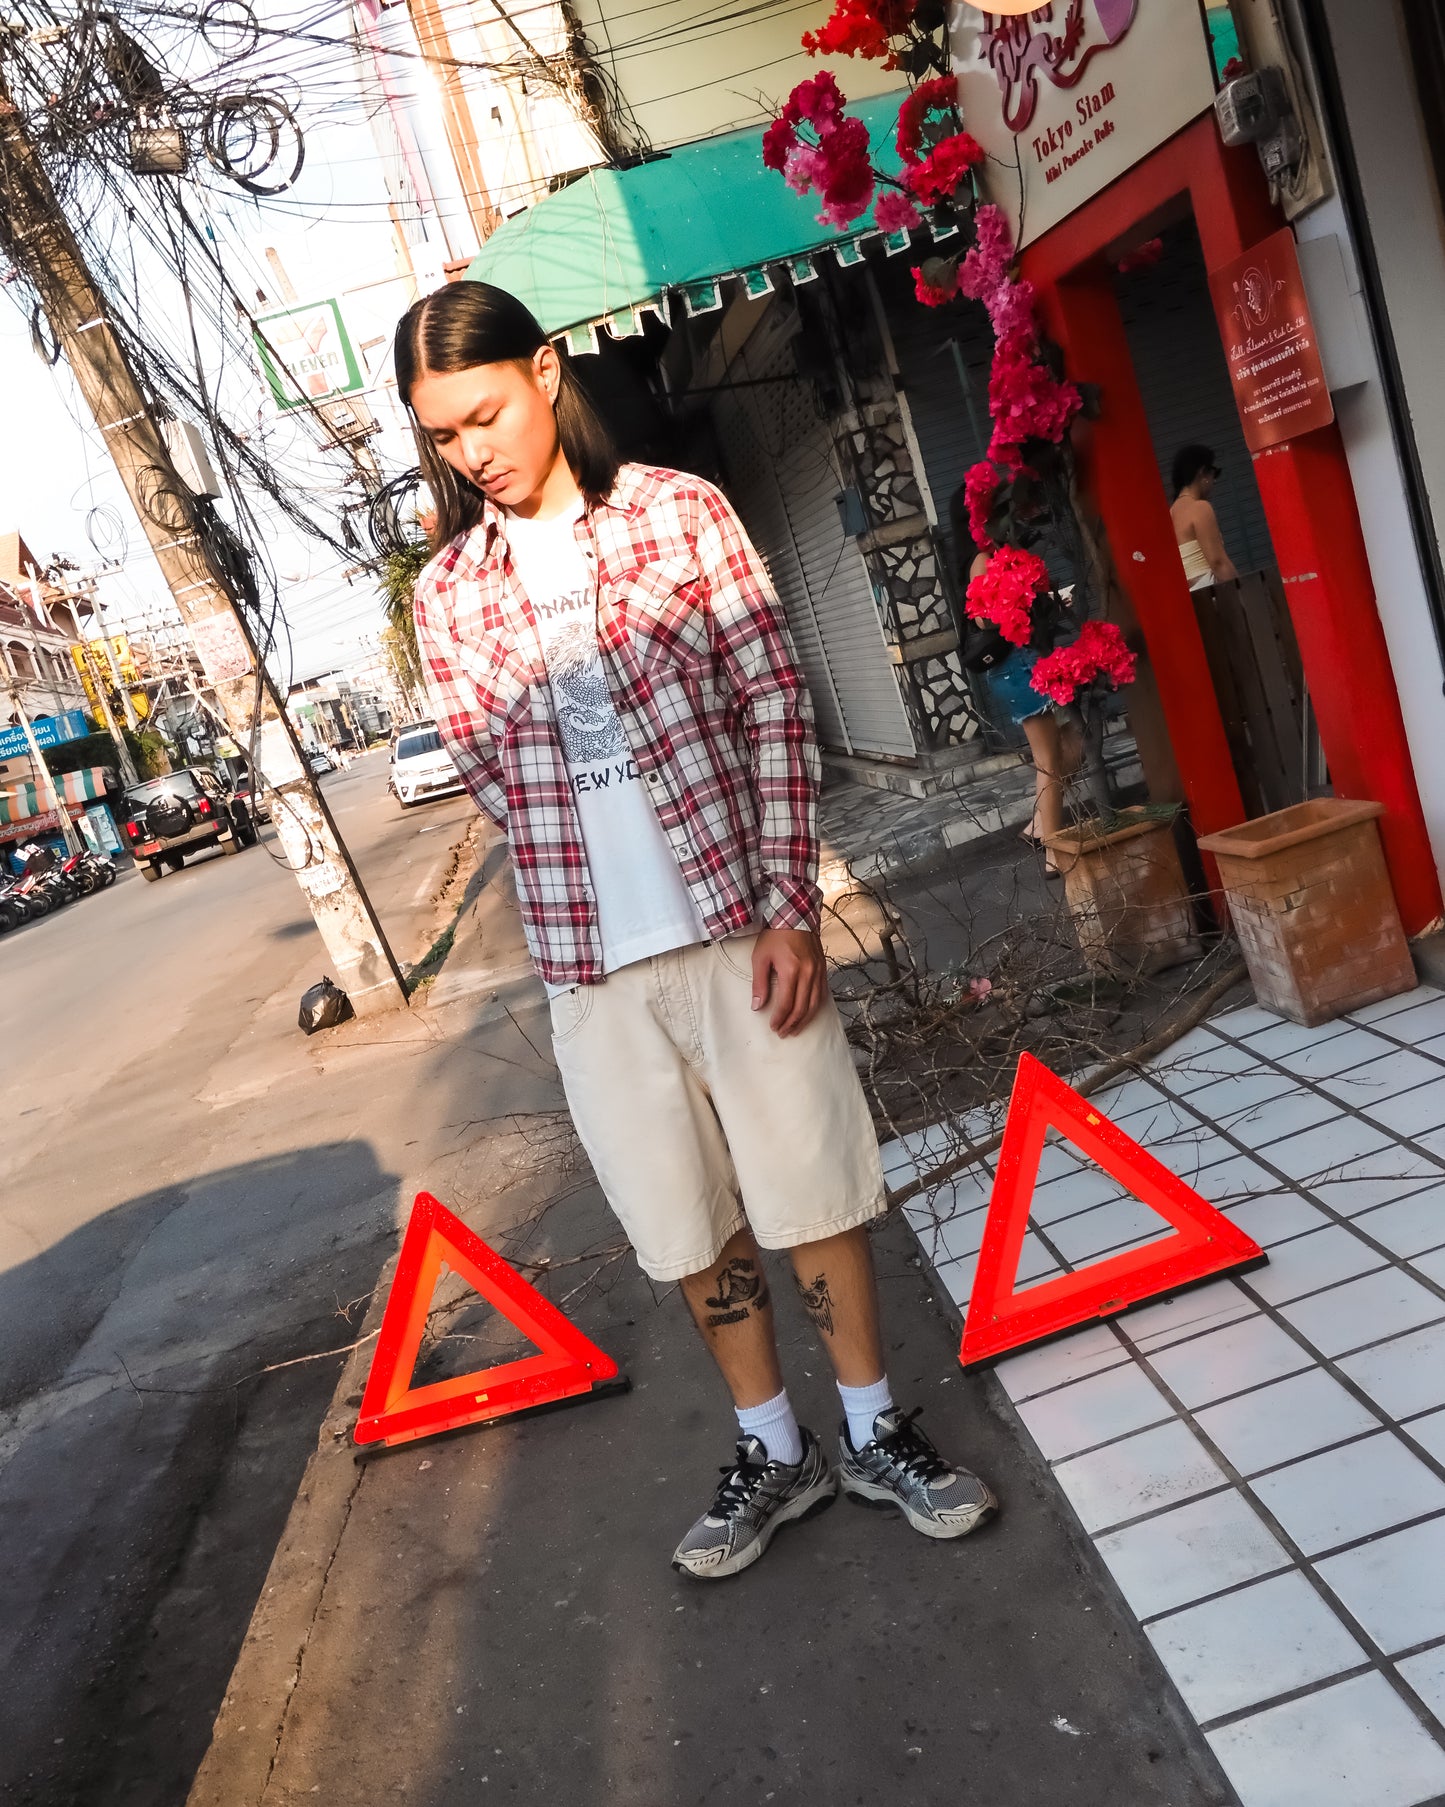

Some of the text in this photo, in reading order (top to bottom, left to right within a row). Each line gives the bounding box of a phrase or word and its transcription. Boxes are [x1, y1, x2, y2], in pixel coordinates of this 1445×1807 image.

[1032, 82, 1116, 163] Tokyo Siam
[1062, 139, 1094, 171] Pancake
[1094, 120, 1115, 144] Rolls
